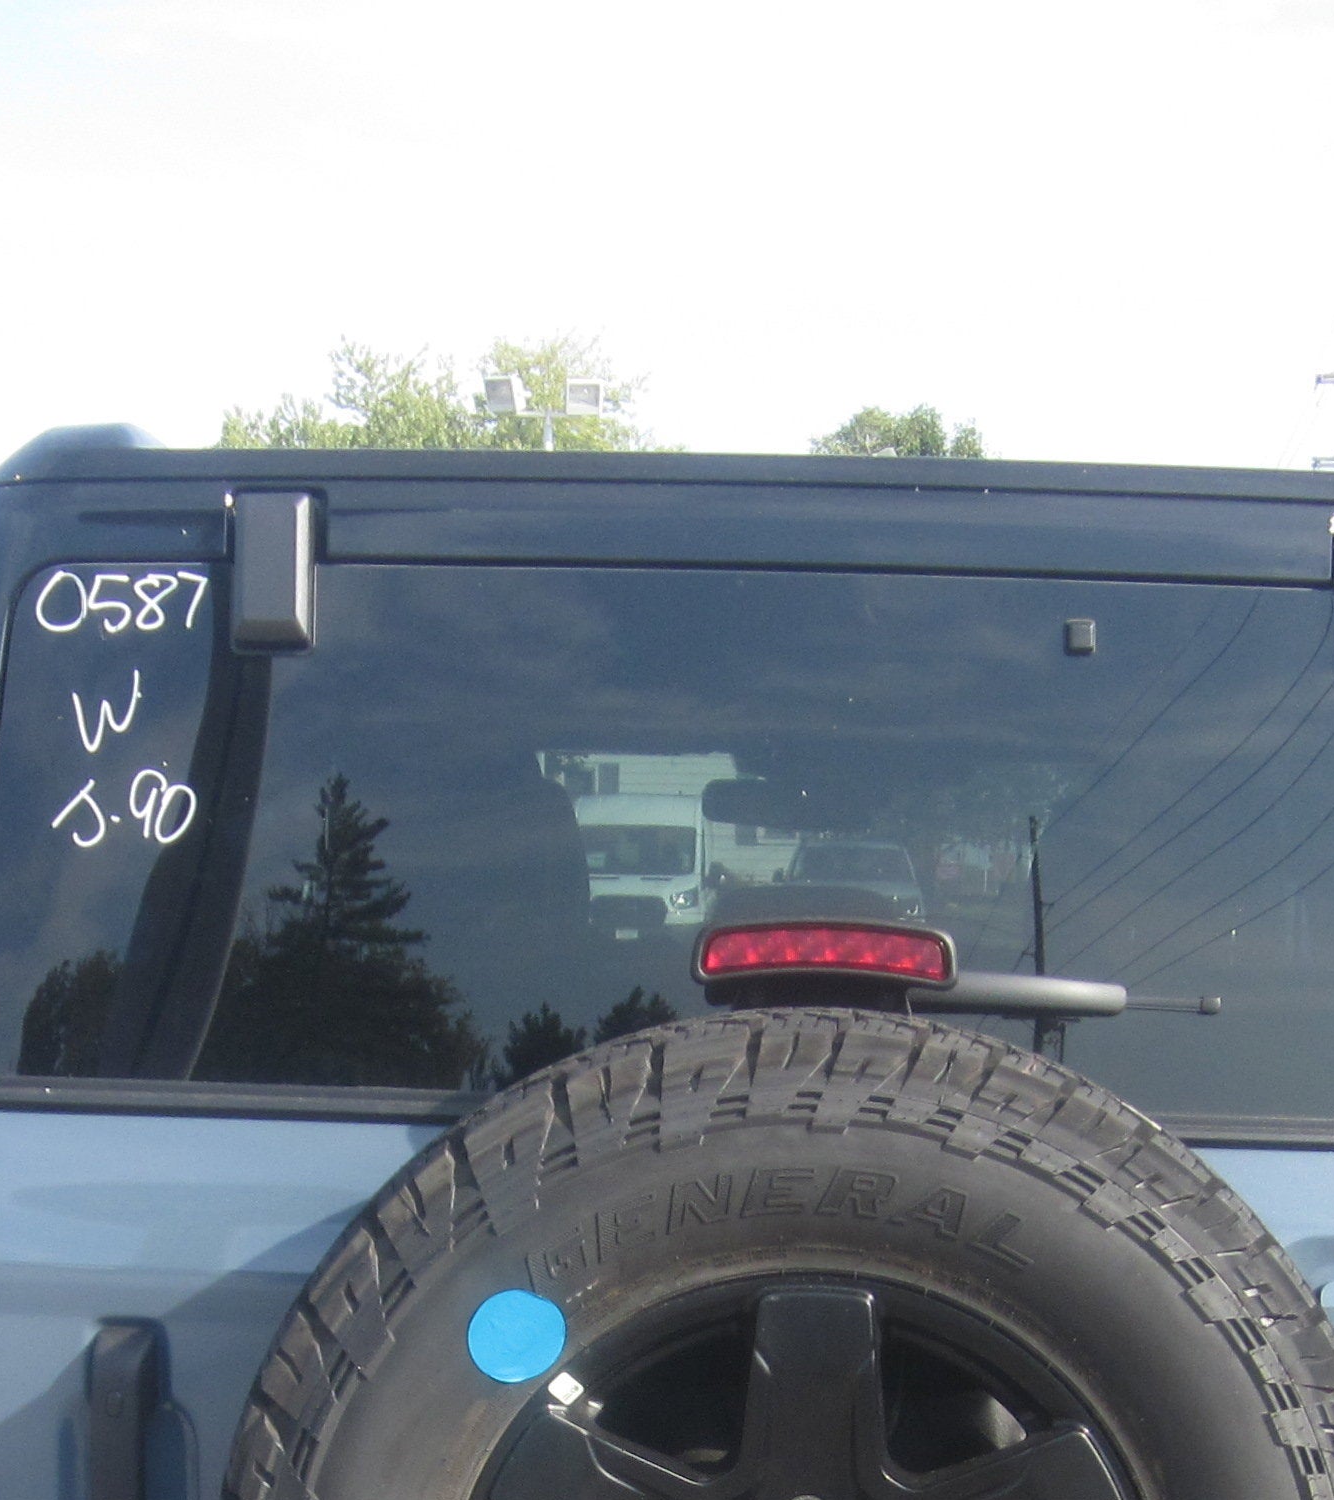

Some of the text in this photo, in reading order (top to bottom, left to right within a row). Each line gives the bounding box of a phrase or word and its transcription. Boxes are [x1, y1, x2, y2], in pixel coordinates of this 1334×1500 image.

[36, 570, 208, 633] 0587
[72, 669, 141, 752] W
[524, 1166, 1035, 1298] GENERAL
